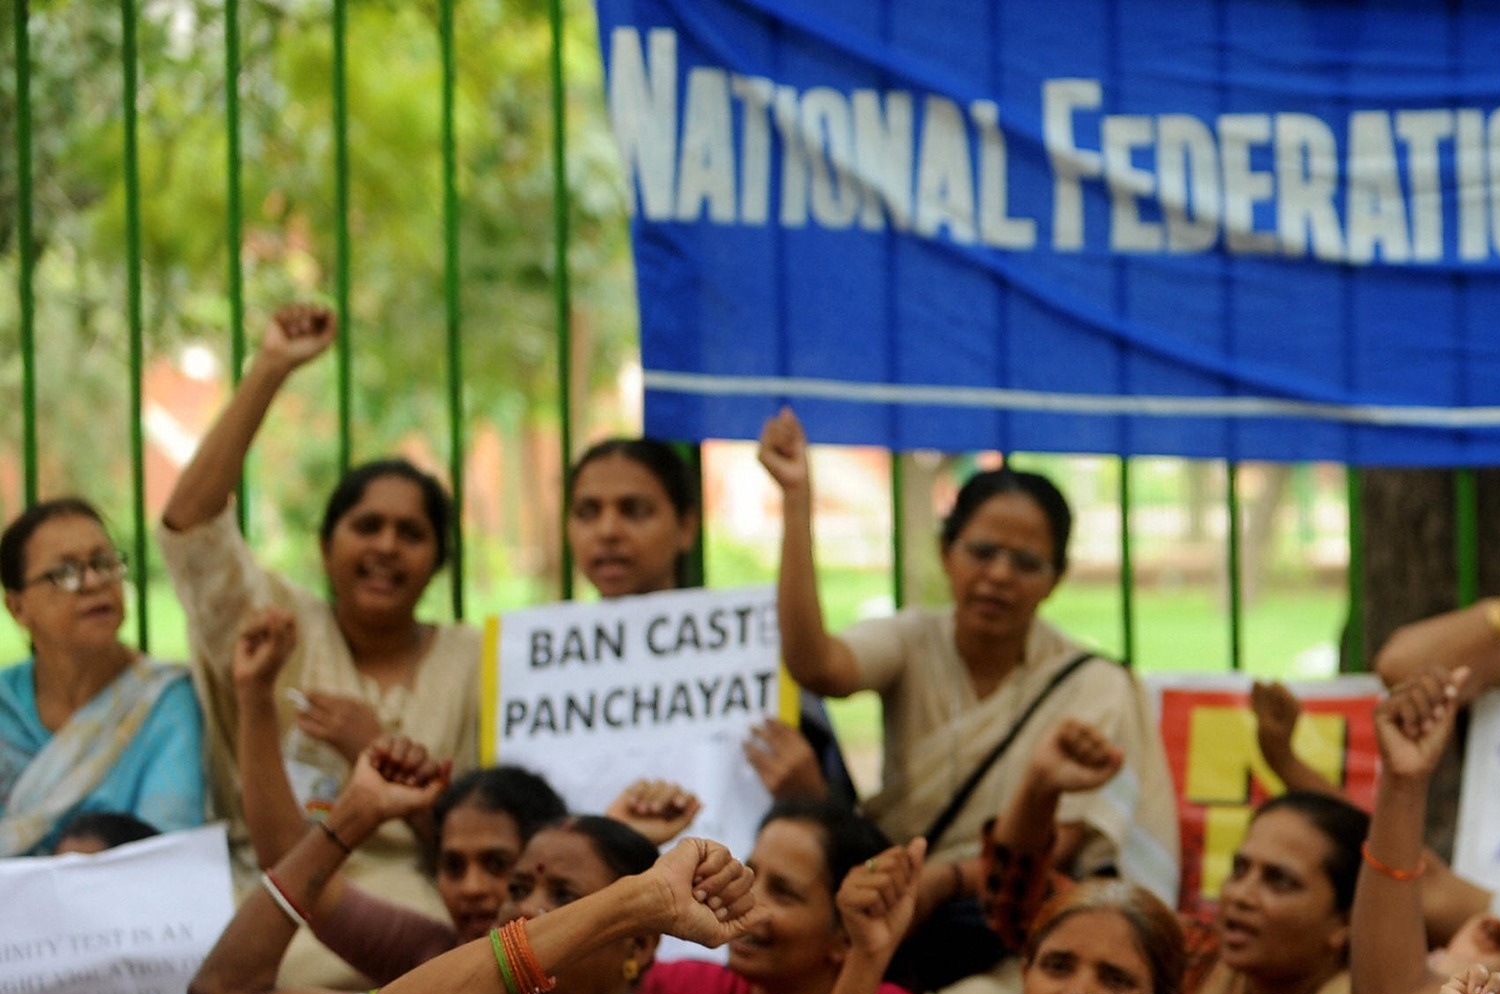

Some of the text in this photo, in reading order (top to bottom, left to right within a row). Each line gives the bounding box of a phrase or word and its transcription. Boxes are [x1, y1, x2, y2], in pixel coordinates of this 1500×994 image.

[609, 28, 1035, 249] NATIONAL
[528, 620, 624, 670] BAN
[505, 671, 775, 736] PANCHAYAT
